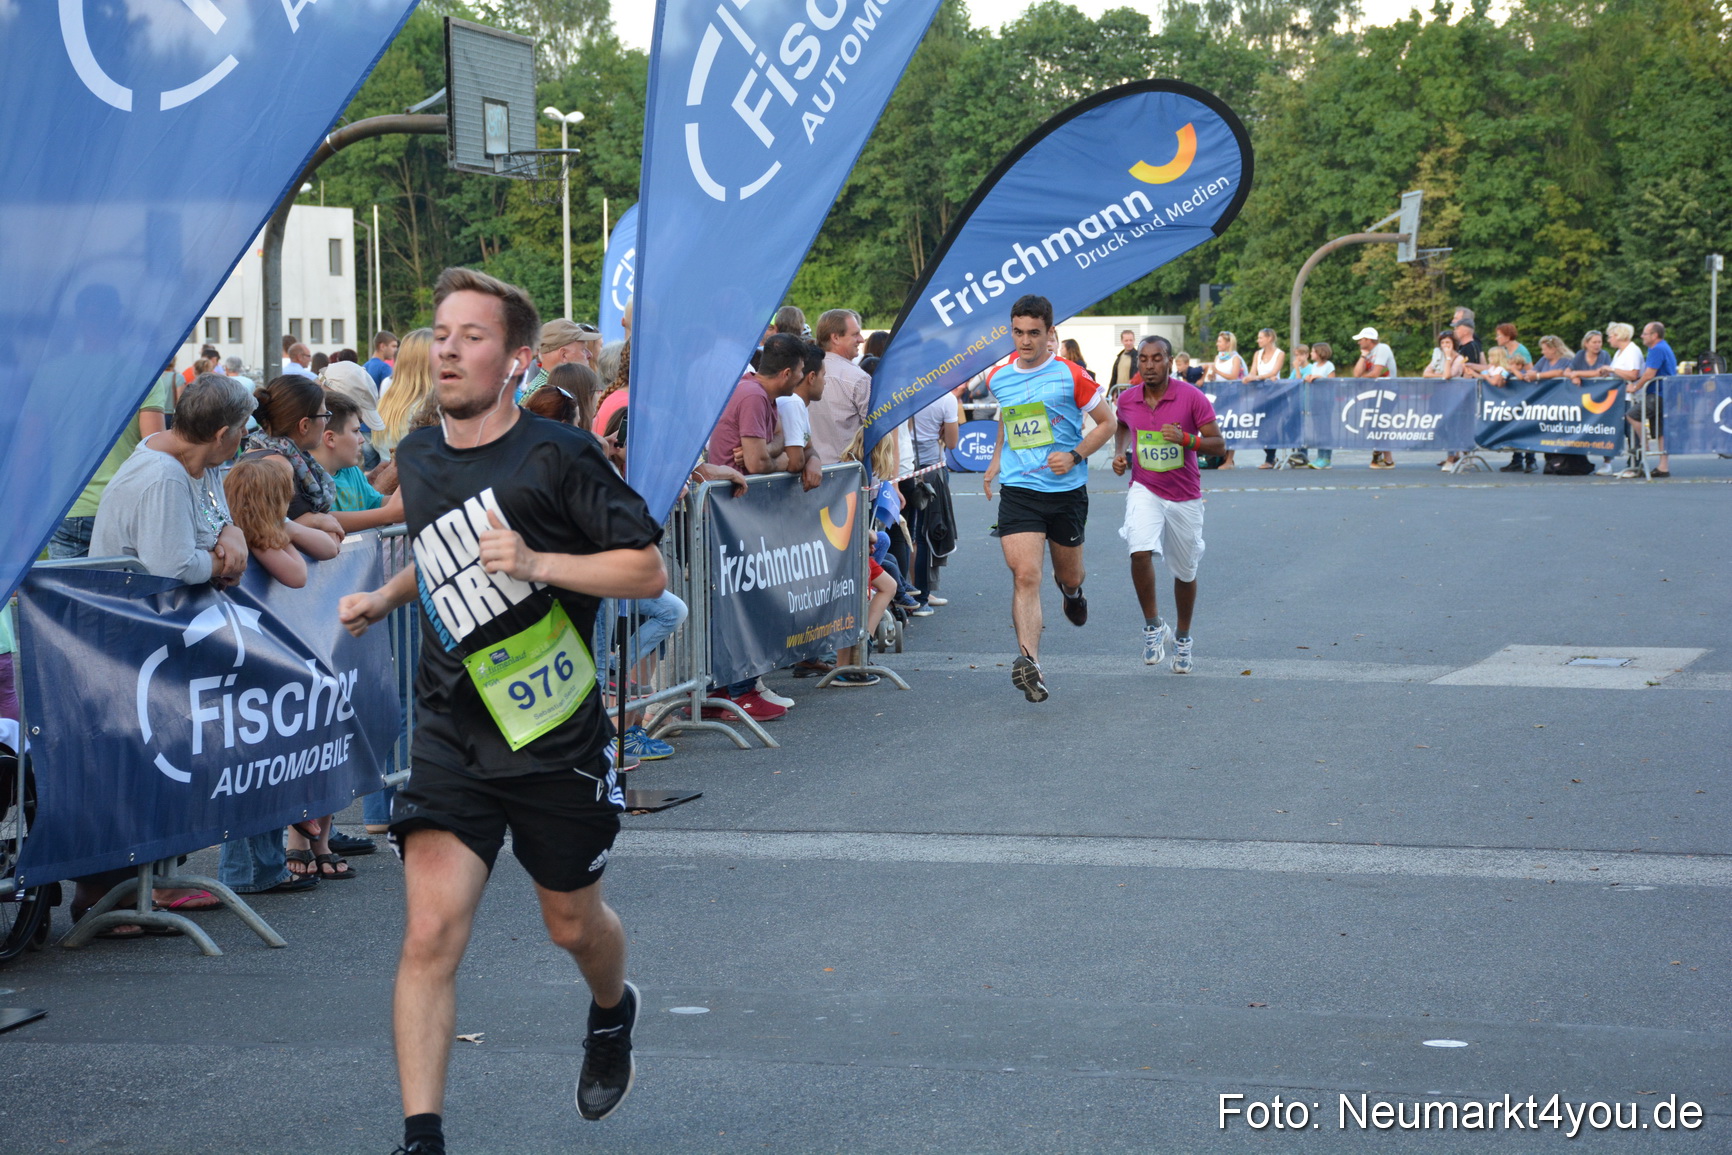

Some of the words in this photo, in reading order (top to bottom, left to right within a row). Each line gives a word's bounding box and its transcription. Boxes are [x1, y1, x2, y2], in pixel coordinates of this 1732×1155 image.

[802, 0, 890, 145] AUTOM
[1074, 232, 1129, 270] Druck
[1130, 213, 1166, 238] und
[1165, 176, 1230, 222] Medien
[930, 190, 1154, 328] Frischmann
[863, 325, 1009, 429] www.frischmann-net.de
[1216, 409, 1266, 428] cher
[1359, 408, 1443, 429] Fischer
[1483, 400, 1582, 421] Frischmann
[1013, 419, 1041, 437] 442
[1366, 431, 1434, 441] AUTOMOBILE
[1539, 422, 1563, 433] Druck
[1564, 423, 1581, 434] und
[969, 442, 996, 454] Fisc
[1142, 447, 1179, 460] 1659
[719, 536, 829, 596] Frischmann
[787, 586, 813, 614] Druck
[814, 581, 831, 607] und
[508, 651, 574, 710] 976
[189, 658, 358, 755] Fischer
[210, 733, 354, 799] AUTOMOBILE
